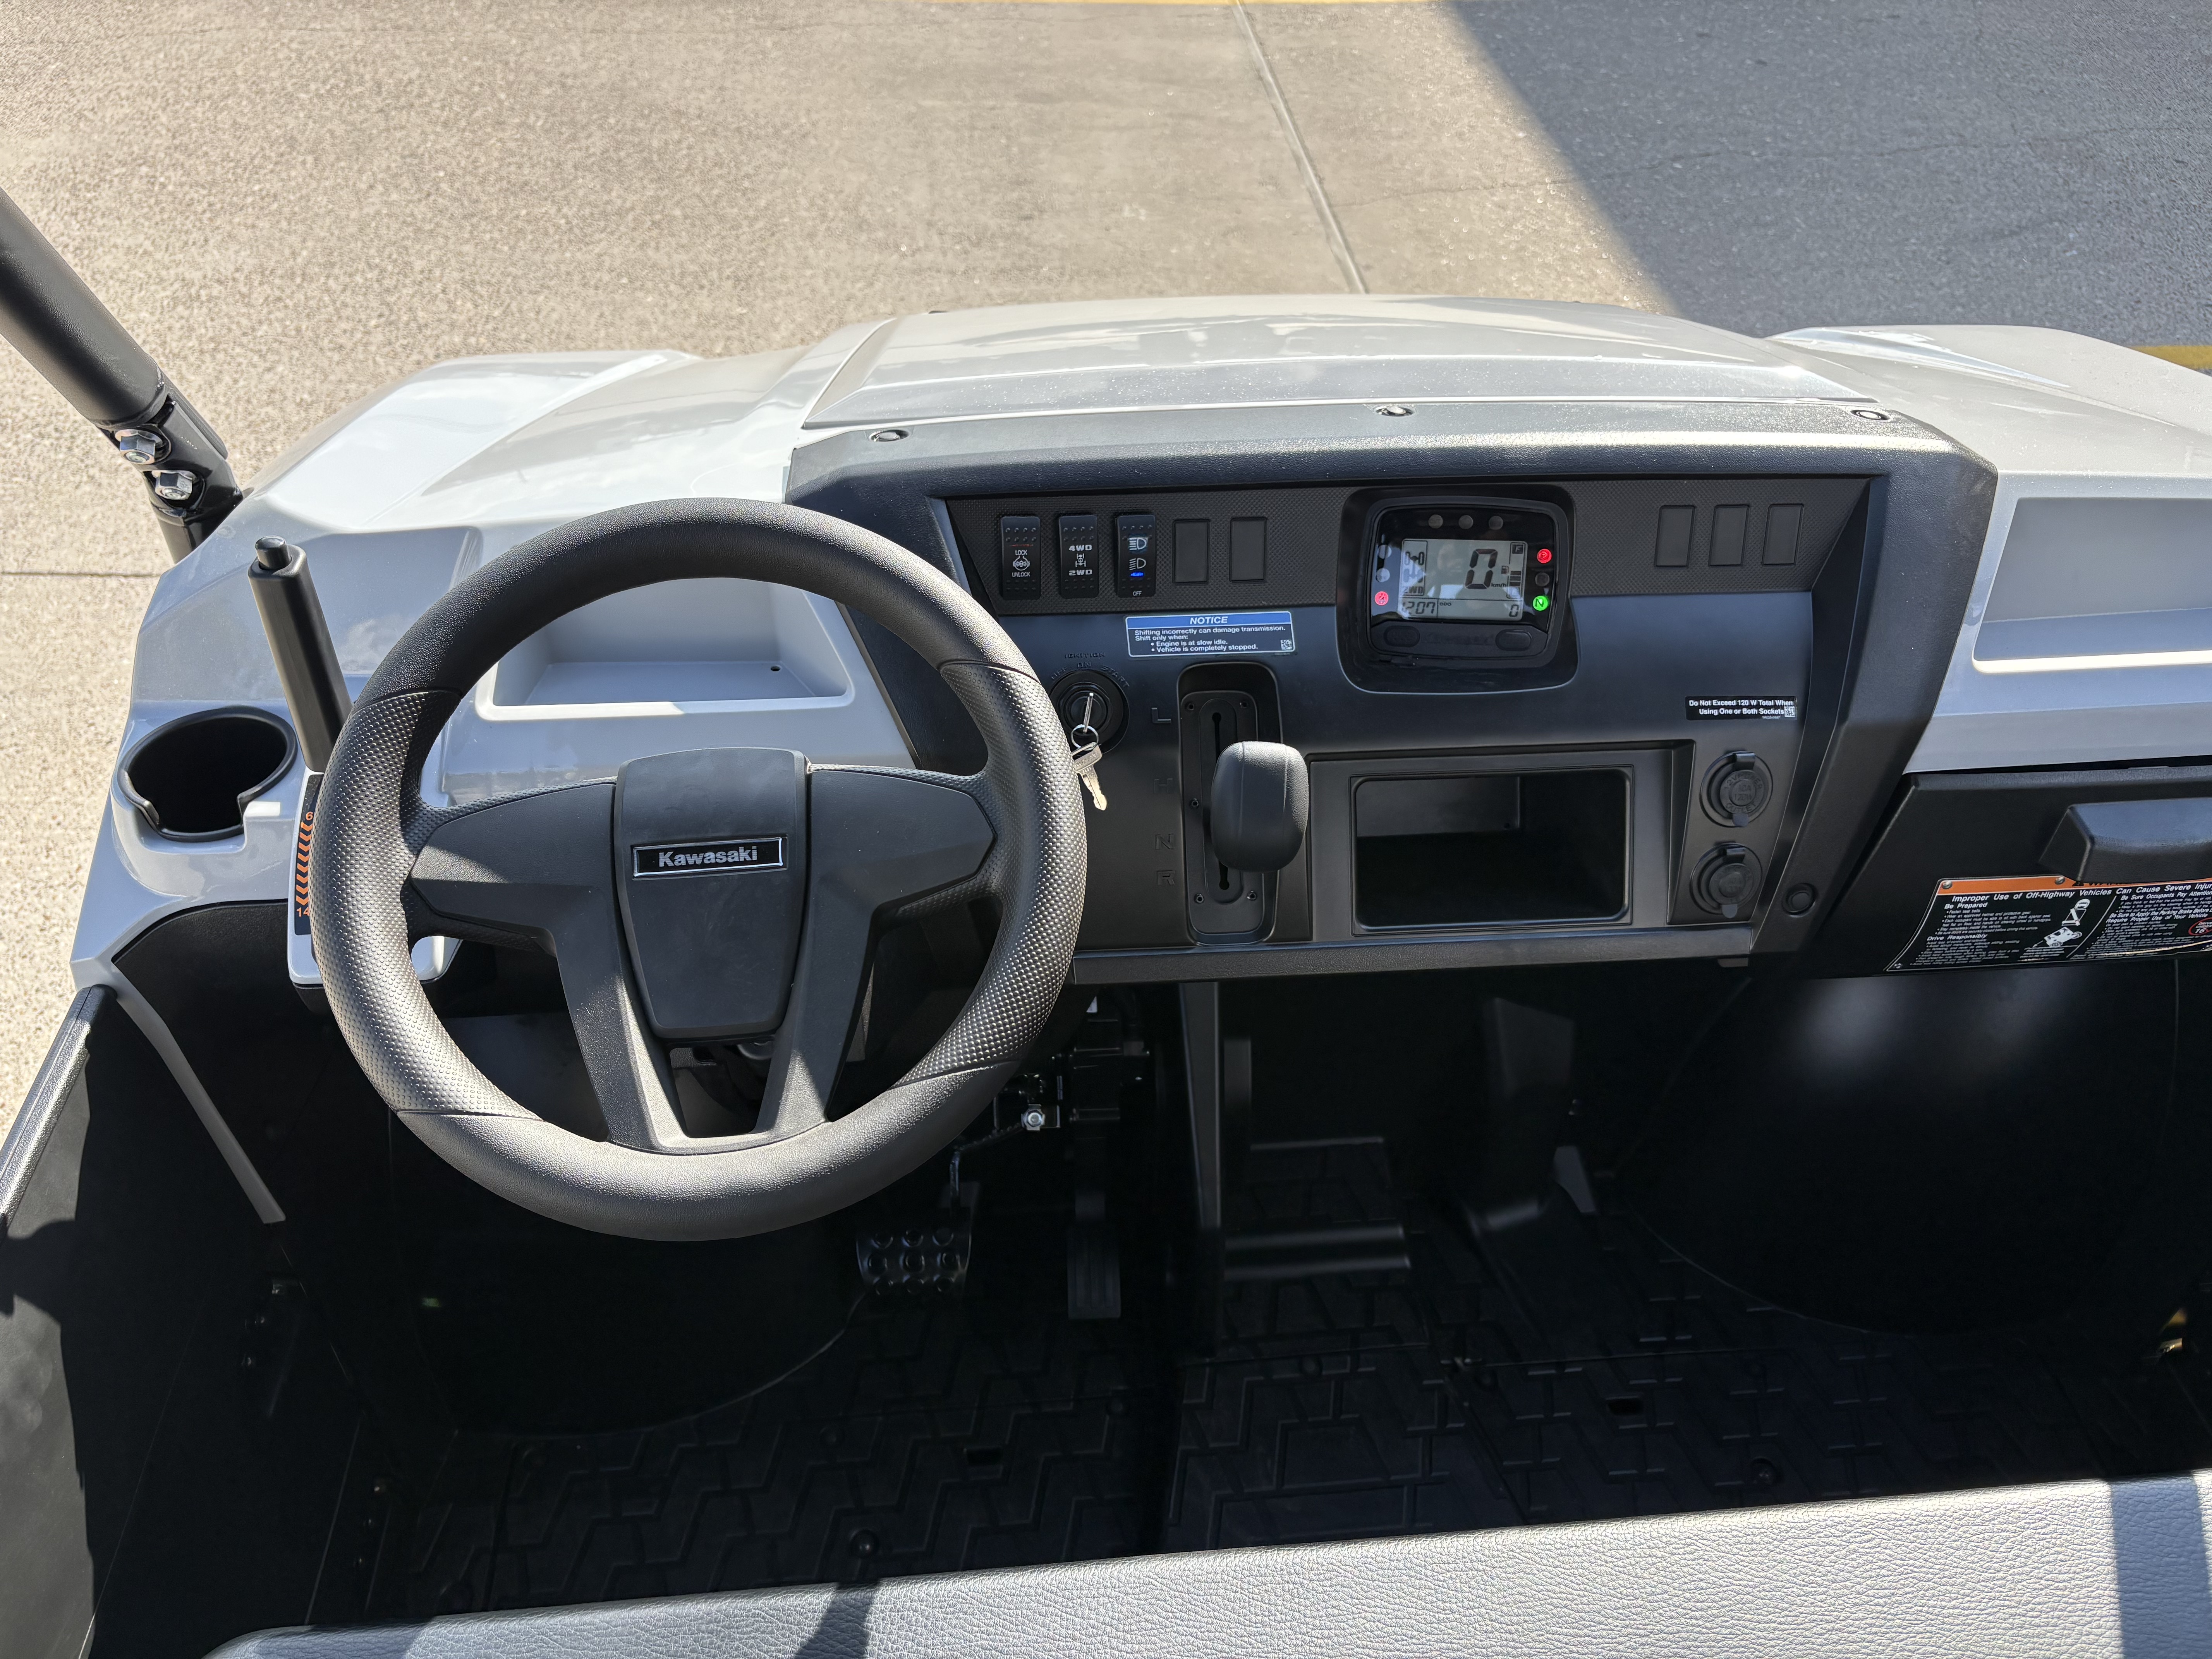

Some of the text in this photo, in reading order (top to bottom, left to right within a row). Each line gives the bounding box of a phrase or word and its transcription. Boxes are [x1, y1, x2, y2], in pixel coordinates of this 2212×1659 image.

[1465, 549, 1498, 589] 0
[1535, 598, 1544, 607] N
[1509, 604, 1519, 617] 0
[1190, 616, 1228, 625] NOTICE
[1100, 665, 1130, 687] START
[1151, 707, 1171, 723] L
[1153, 778, 1173, 794] H
[1726, 801, 1756, 813] OUTLET
[306, 811, 313, 820] 6
[1155, 833, 1175, 850] N
[659, 846, 757, 867] Kawasaki
[1156, 870, 1175, 886] R
[2026, 891, 2075, 899] Off-Highway
[296, 907, 309, 917] 14
